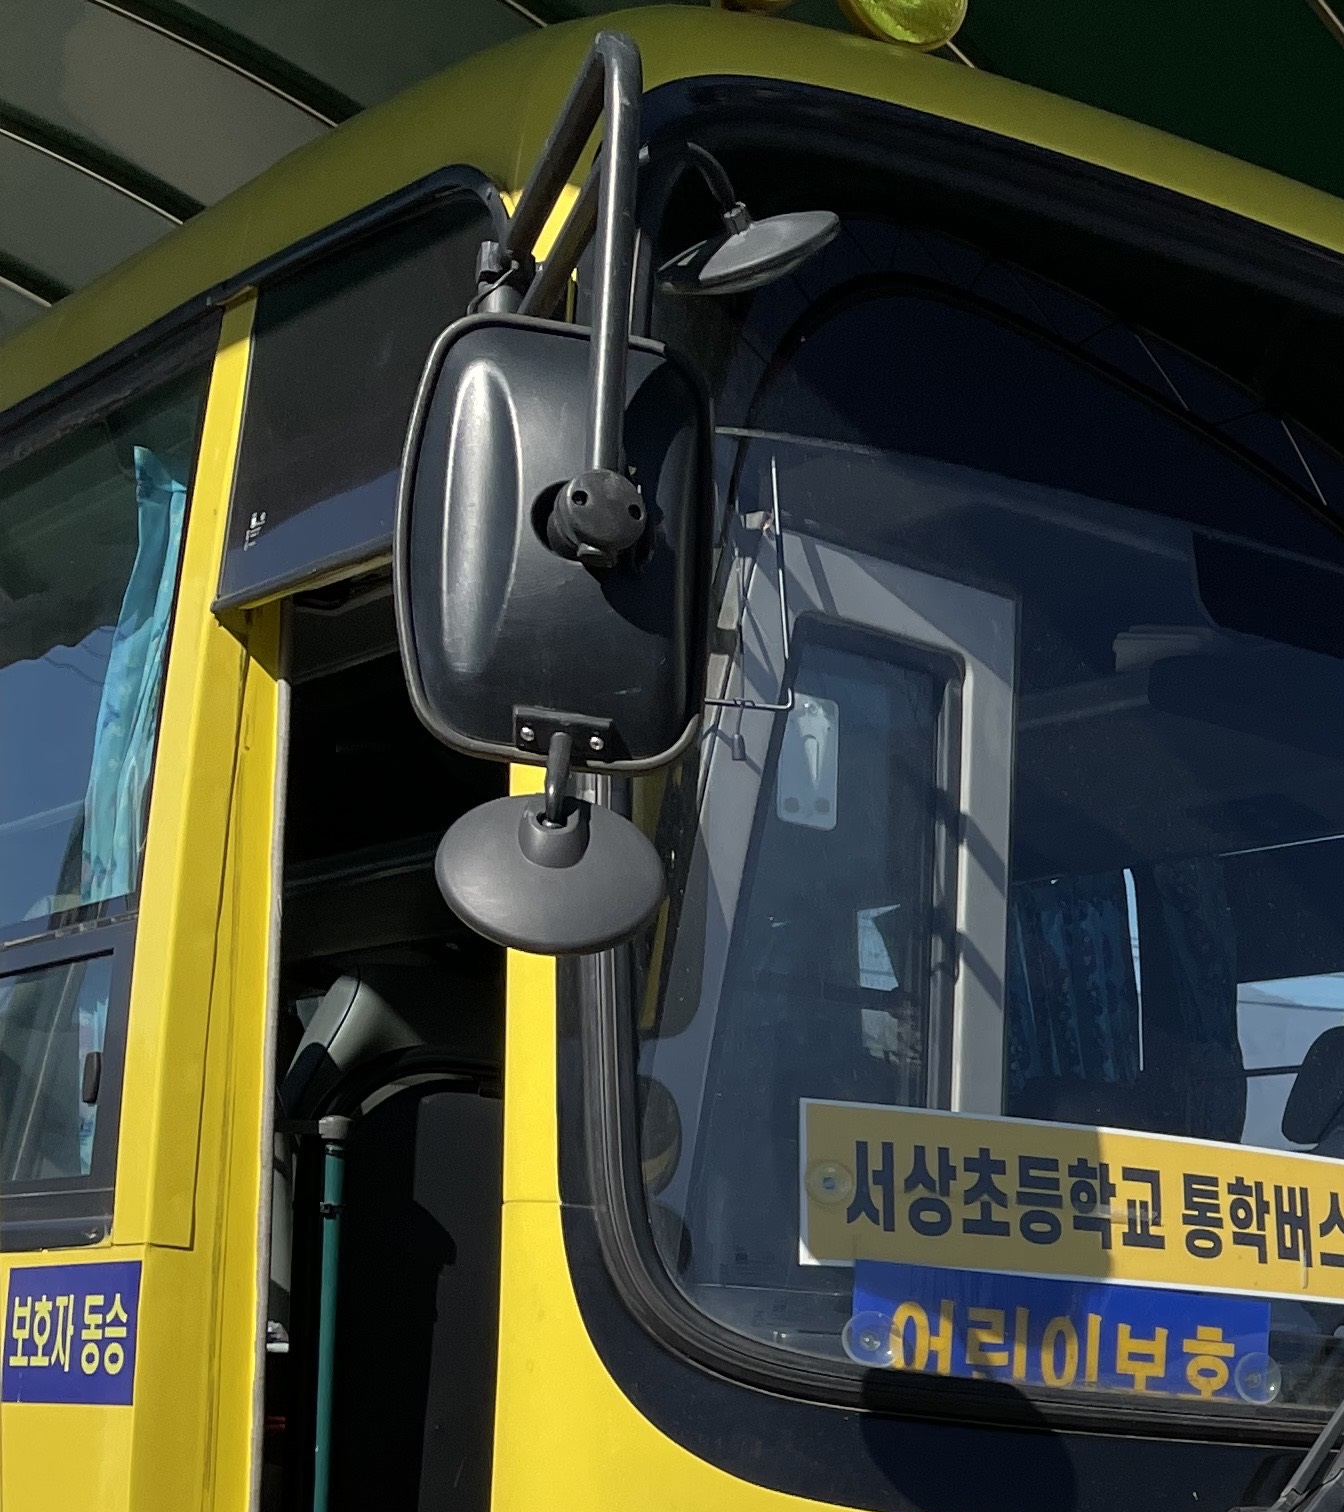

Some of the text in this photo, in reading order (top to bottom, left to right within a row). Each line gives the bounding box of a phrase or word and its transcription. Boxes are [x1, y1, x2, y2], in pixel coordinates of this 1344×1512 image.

[847, 1140, 1166, 1251] 서상초등학교
[9, 1293, 128, 1375] 보호자 동승
